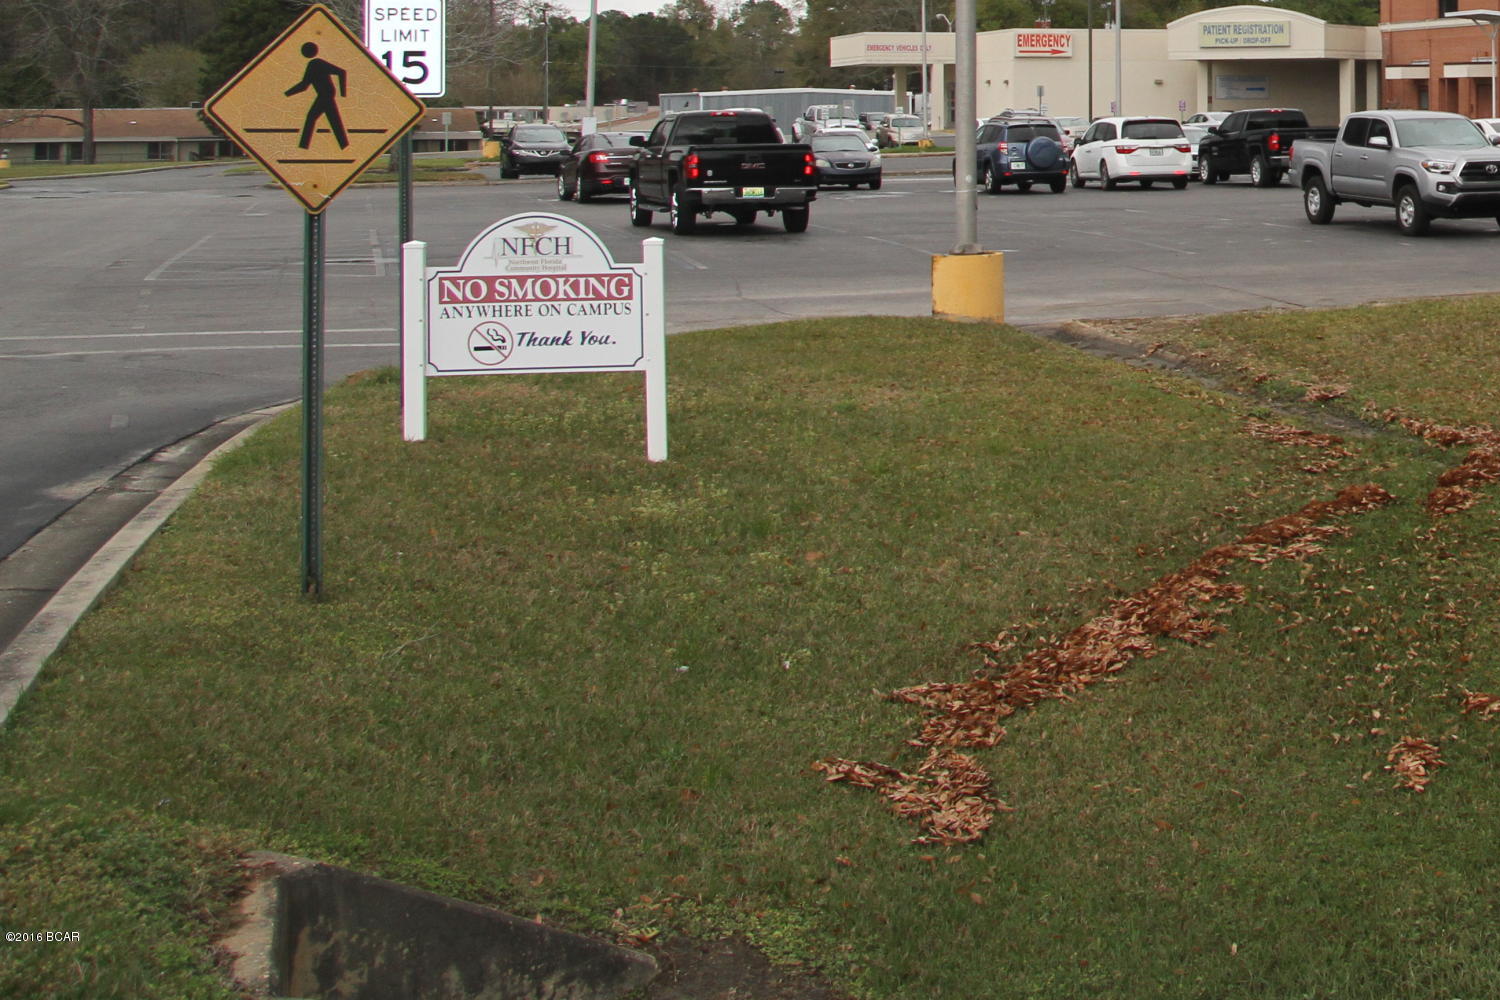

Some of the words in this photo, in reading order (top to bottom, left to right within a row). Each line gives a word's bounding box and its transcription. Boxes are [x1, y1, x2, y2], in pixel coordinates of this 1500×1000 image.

[374, 7, 438, 21] SPEED
[381, 29, 430, 42] LIMIT
[1203, 24, 1231, 35] PATIENT
[1233, 23, 1284, 35] REGISTRATION
[1017, 33, 1071, 48] EMERGENCY
[381, 50, 429, 85] 15
[501, 236, 572, 256] NFCH
[441, 279, 488, 302] NO
[494, 276, 631, 301] SMOKING
[440, 304, 534, 319] ANYWHERE
[538, 303, 562, 316] ON
[567, 302, 632, 316] CAMPUS
[515, 330, 573, 347] Thank
[579, 330, 617, 346] You.
